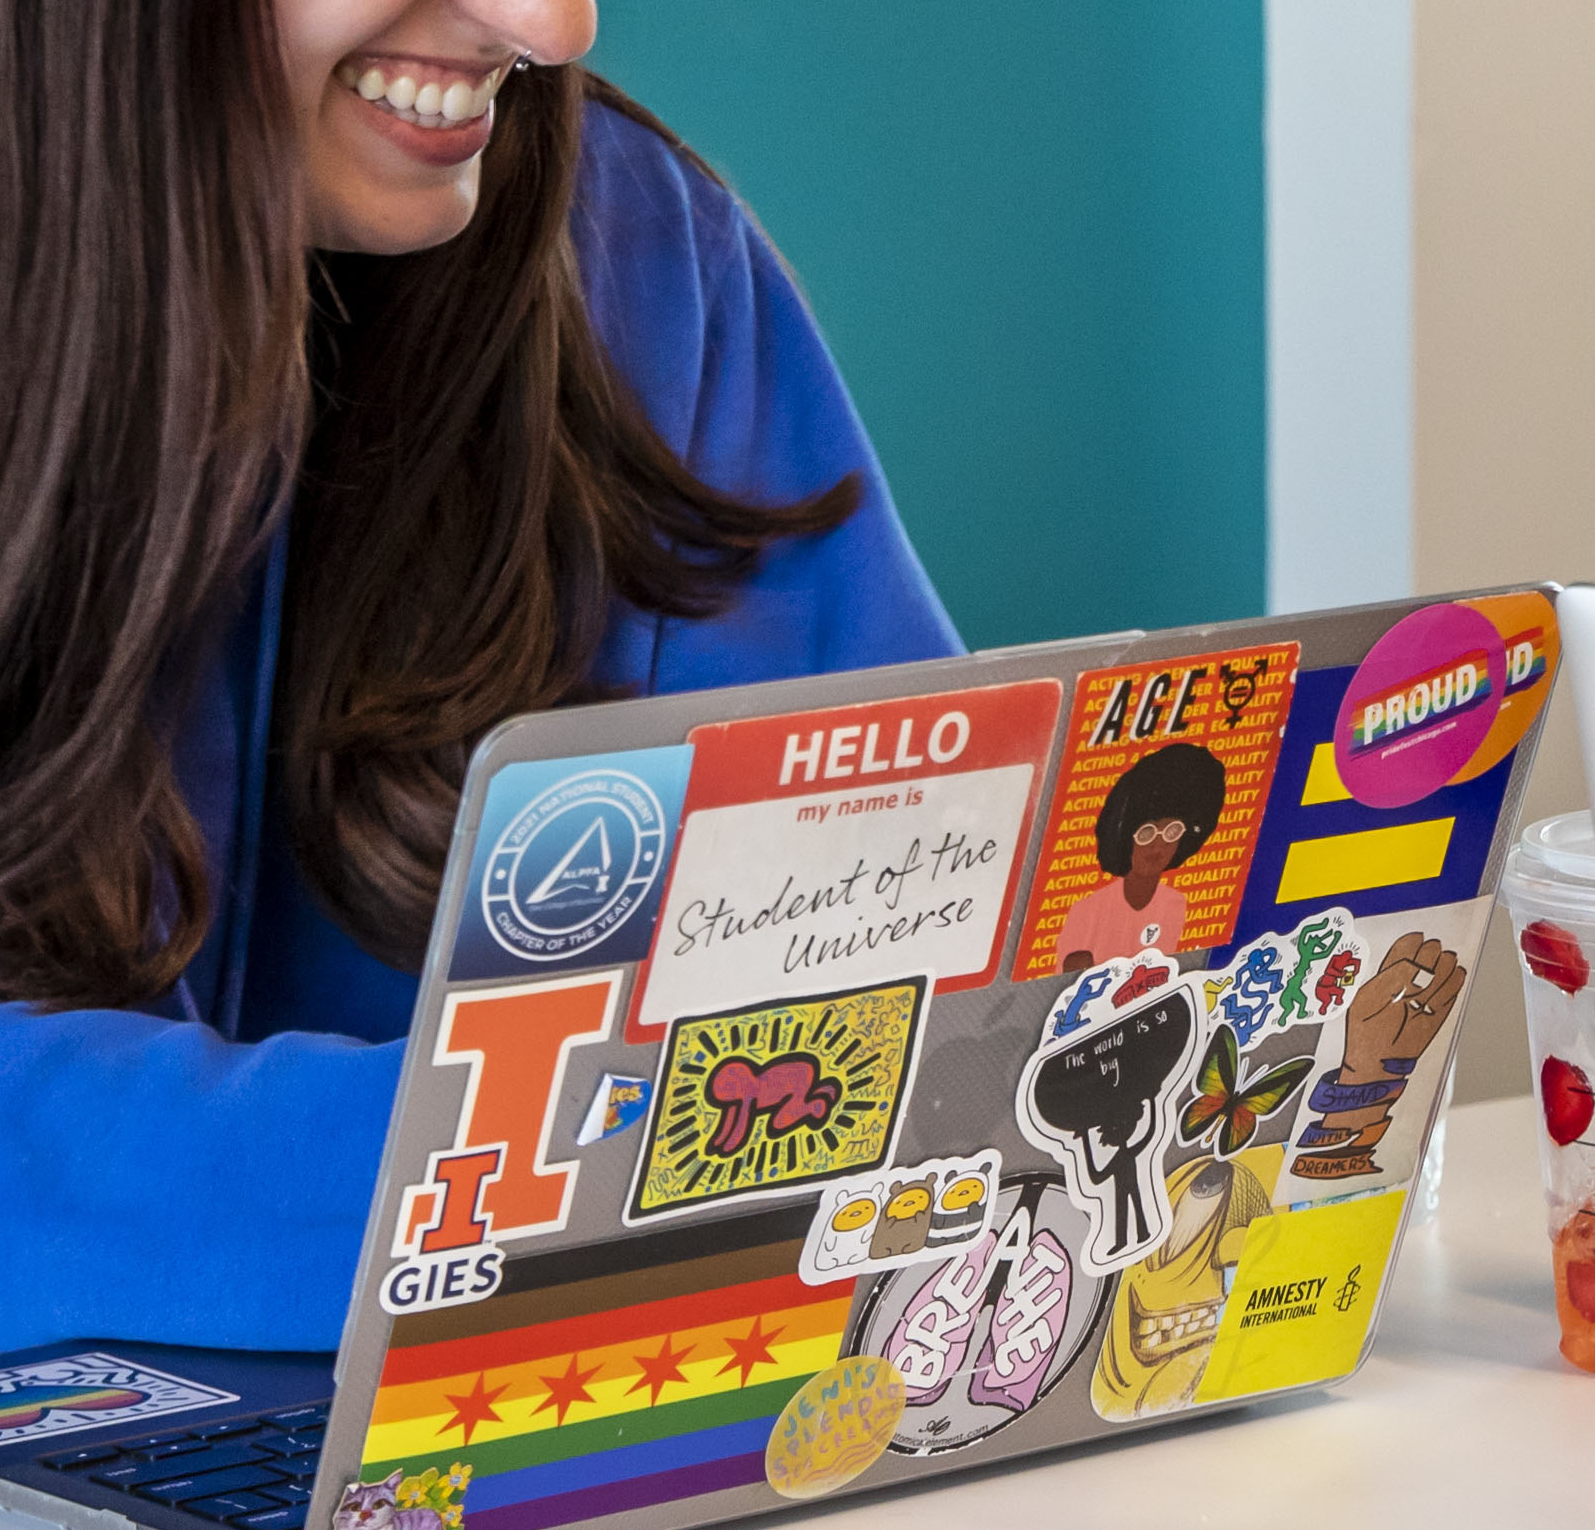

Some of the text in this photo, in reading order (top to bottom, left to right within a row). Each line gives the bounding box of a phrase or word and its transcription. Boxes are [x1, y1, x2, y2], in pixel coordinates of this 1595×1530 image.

[1087, 667, 1208, 749] AGE
[1363, 663, 1478, 746] PROUD
[778, 711, 971, 786] HELLO
[1071, 752, 1126, 774] ACTING
[796, 786, 924, 824] my name is
[673, 832, 998, 957] Student of the
[1043, 871, 1100, 892] ACTING
[1172, 865, 1241, 888] EQUALITY
[495, 911, 545, 950] CHAPTER
[546, 937, 565, 951] OF
[569, 926, 596, 946] THE
[597, 896, 633, 929] YEAR
[783, 898, 974, 974] Universe
[1064, 1010, 1168, 1070] The world is so
[1099, 1058, 1120, 1087] big
[1293, 1155, 1367, 1175] DREAMERS
[389, 1252, 499, 1307] GIES
[1245, 1277, 1328, 1312] AMNESTY
[1239, 1302, 1318, 1329] INTERNATIONAL
